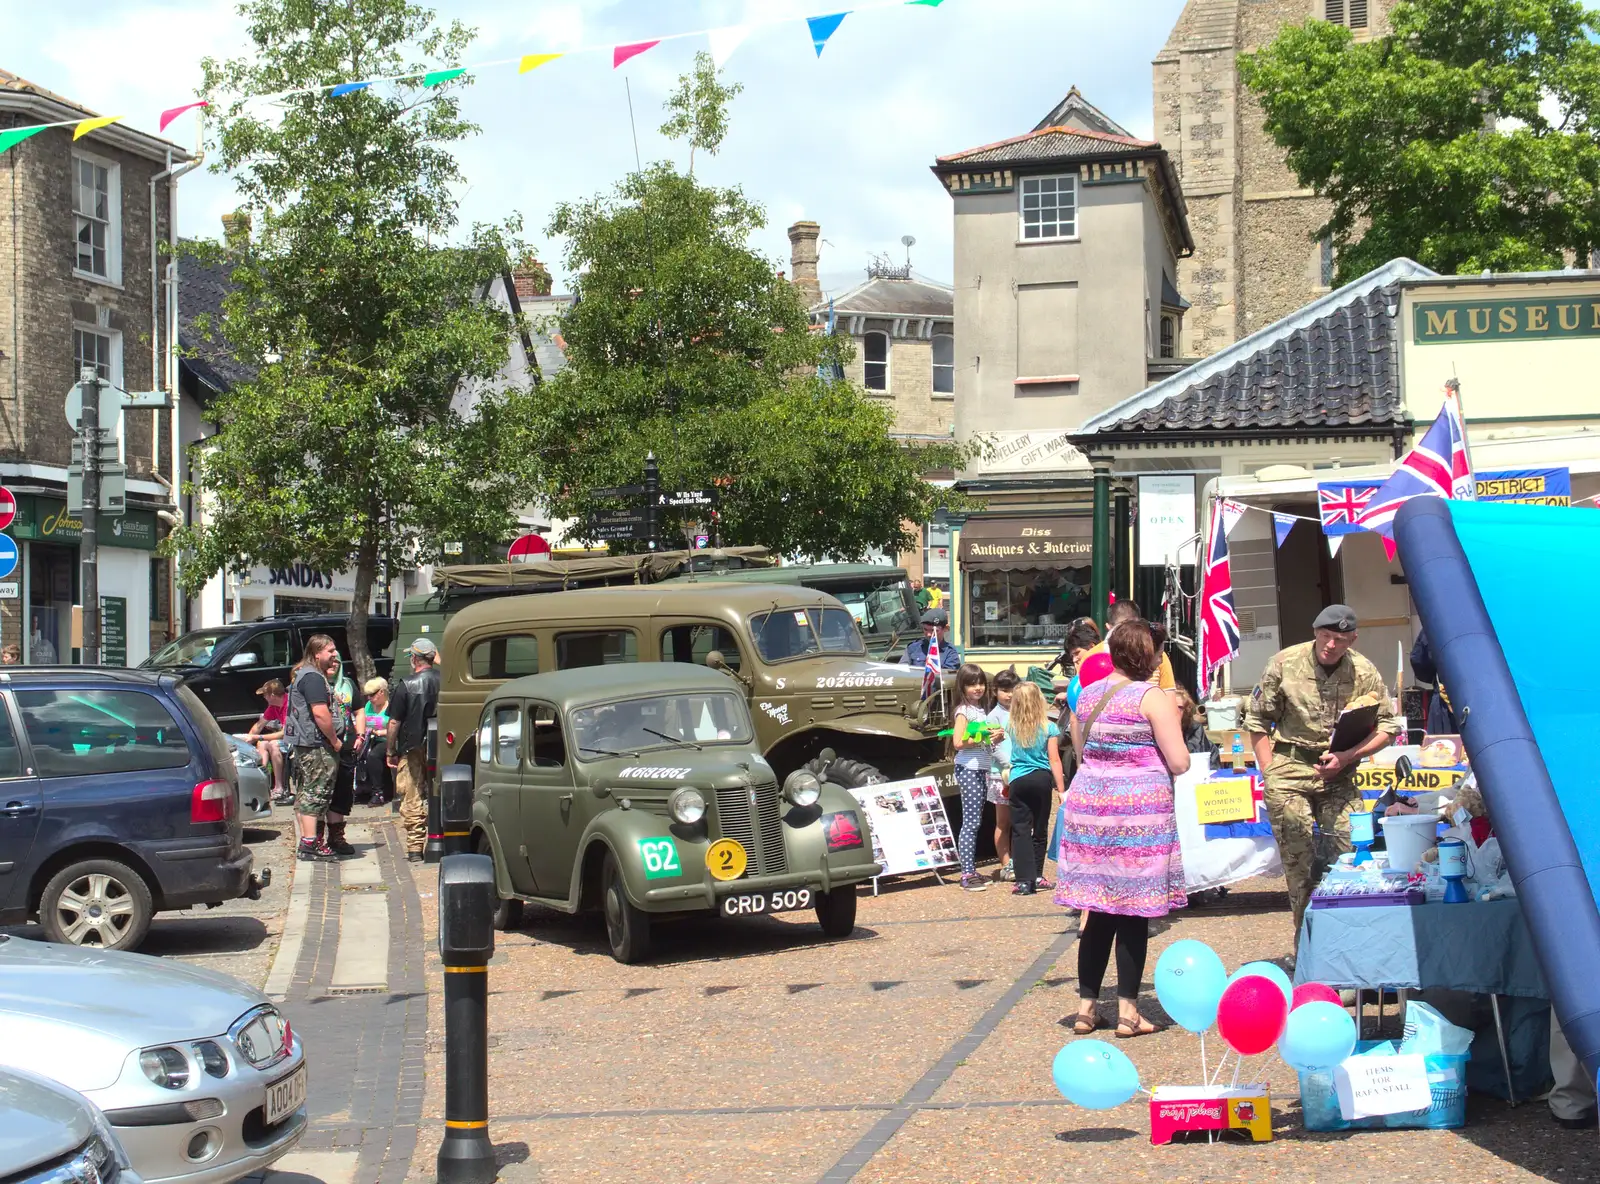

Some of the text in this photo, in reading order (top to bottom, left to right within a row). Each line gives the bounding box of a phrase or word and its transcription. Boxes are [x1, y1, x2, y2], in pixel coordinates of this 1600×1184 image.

[1425, 303, 1600, 335] MUSEU
[1021, 448, 1043, 466] GIFT
[1061, 448, 1082, 464] WA
[1476, 478, 1542, 495] DISTRICT
[42, 505, 83, 535] Johnso
[1150, 516, 1185, 524] OPEN
[1021, 528, 1052, 536] Diss
[971, 541, 1092, 558] Antiques & Interior
[775, 678, 787, 690] S
[815, 676, 894, 689] 20260994
[1354, 772, 1394, 787] DISS
[1404, 773, 1440, 788] AND
[1214, 788, 1229, 796] RBL
[1203, 796, 1242, 806] WOMEN'S
[1204, 808, 1241, 817] SECTION
[641, 841, 678, 872] 62
[719, 850, 734, 870] 2
[724, 889, 810, 915] CRD 509
[1365, 1066, 1394, 1076] ITEMS
[1372, 1076, 1391, 1085] FOR
[1382, 1084, 1412, 1092] STALL
